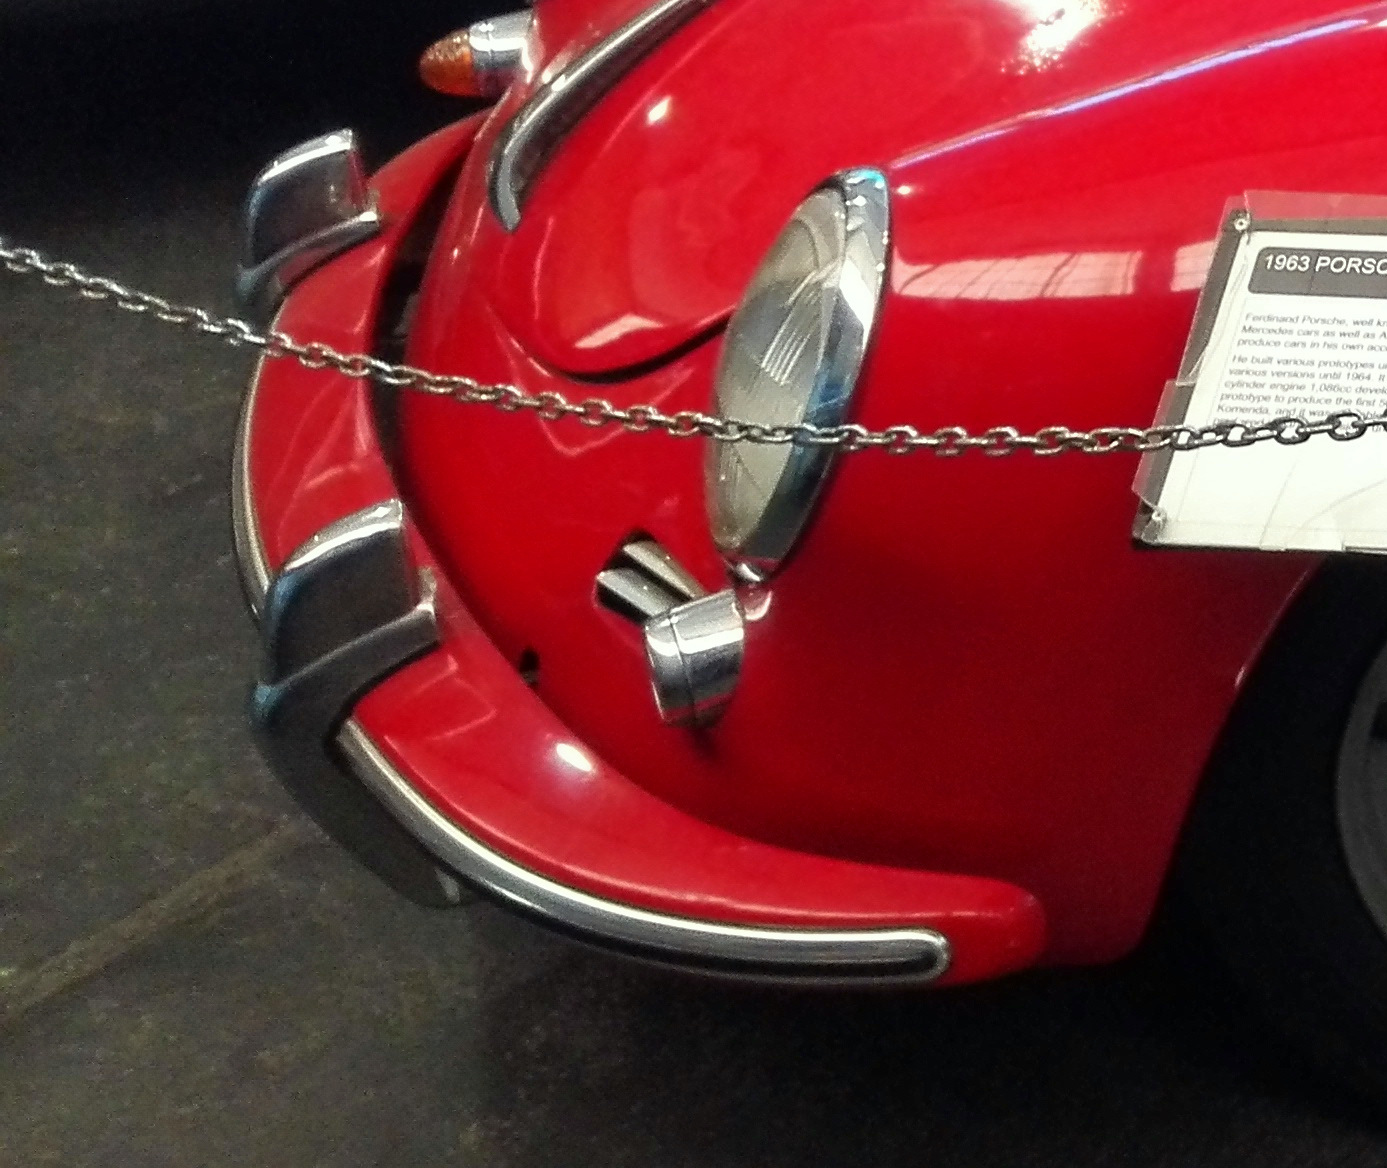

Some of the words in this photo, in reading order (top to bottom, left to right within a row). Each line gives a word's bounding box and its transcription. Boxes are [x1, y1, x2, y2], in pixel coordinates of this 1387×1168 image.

[1265, 254, 1310, 272] 1963
[1244, 312, 1300, 322] Ferdinand
[1351, 317, 1375, 326] well
[1240, 324, 1295, 334] Mercedes
[1337, 329, 1361, 337] well
[1235, 336, 1282, 348] produce
[1321, 340, 1339, 349] his
[1249, 355, 1274, 363] built
[1275, 356, 1316, 366] various
[1316, 358, 1376, 370] prototypes
